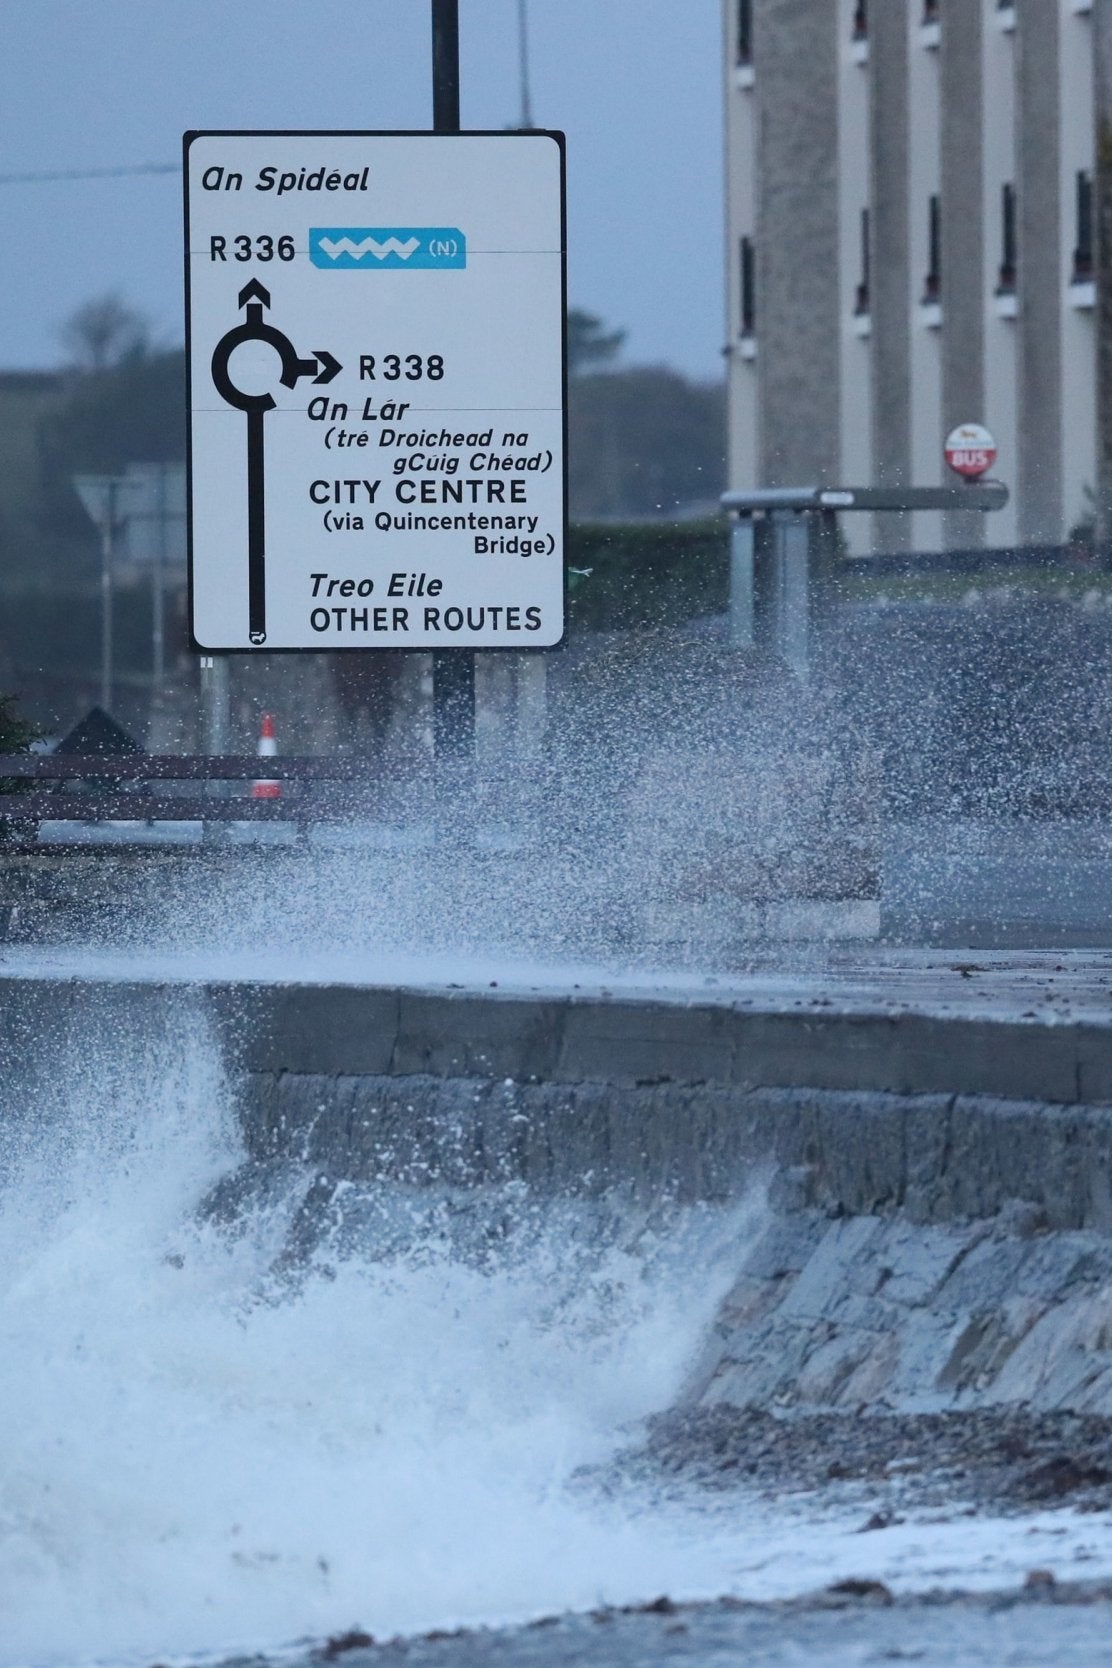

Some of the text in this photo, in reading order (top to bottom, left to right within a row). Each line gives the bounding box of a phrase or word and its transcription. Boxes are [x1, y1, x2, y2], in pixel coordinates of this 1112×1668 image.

[202, 166, 371, 195] An Spidéal
[210, 235, 458, 262] R336 (N)
[360, 355, 444, 380] R338
[307, 397, 410, 421] An Lár
[325, 427, 528, 449] (tré Droichead na
[392, 450, 552, 474] gCúig Chéad)
[952, 451, 988, 467] BUS
[309, 480, 527, 504] CITY CENTRE
[324, 510, 538, 533] (via Quincentenary
[475, 533, 555, 557] Bridge)
[310, 573, 442, 597] Treo Eile
[310, 607, 541, 632] OTHER ROUTES
